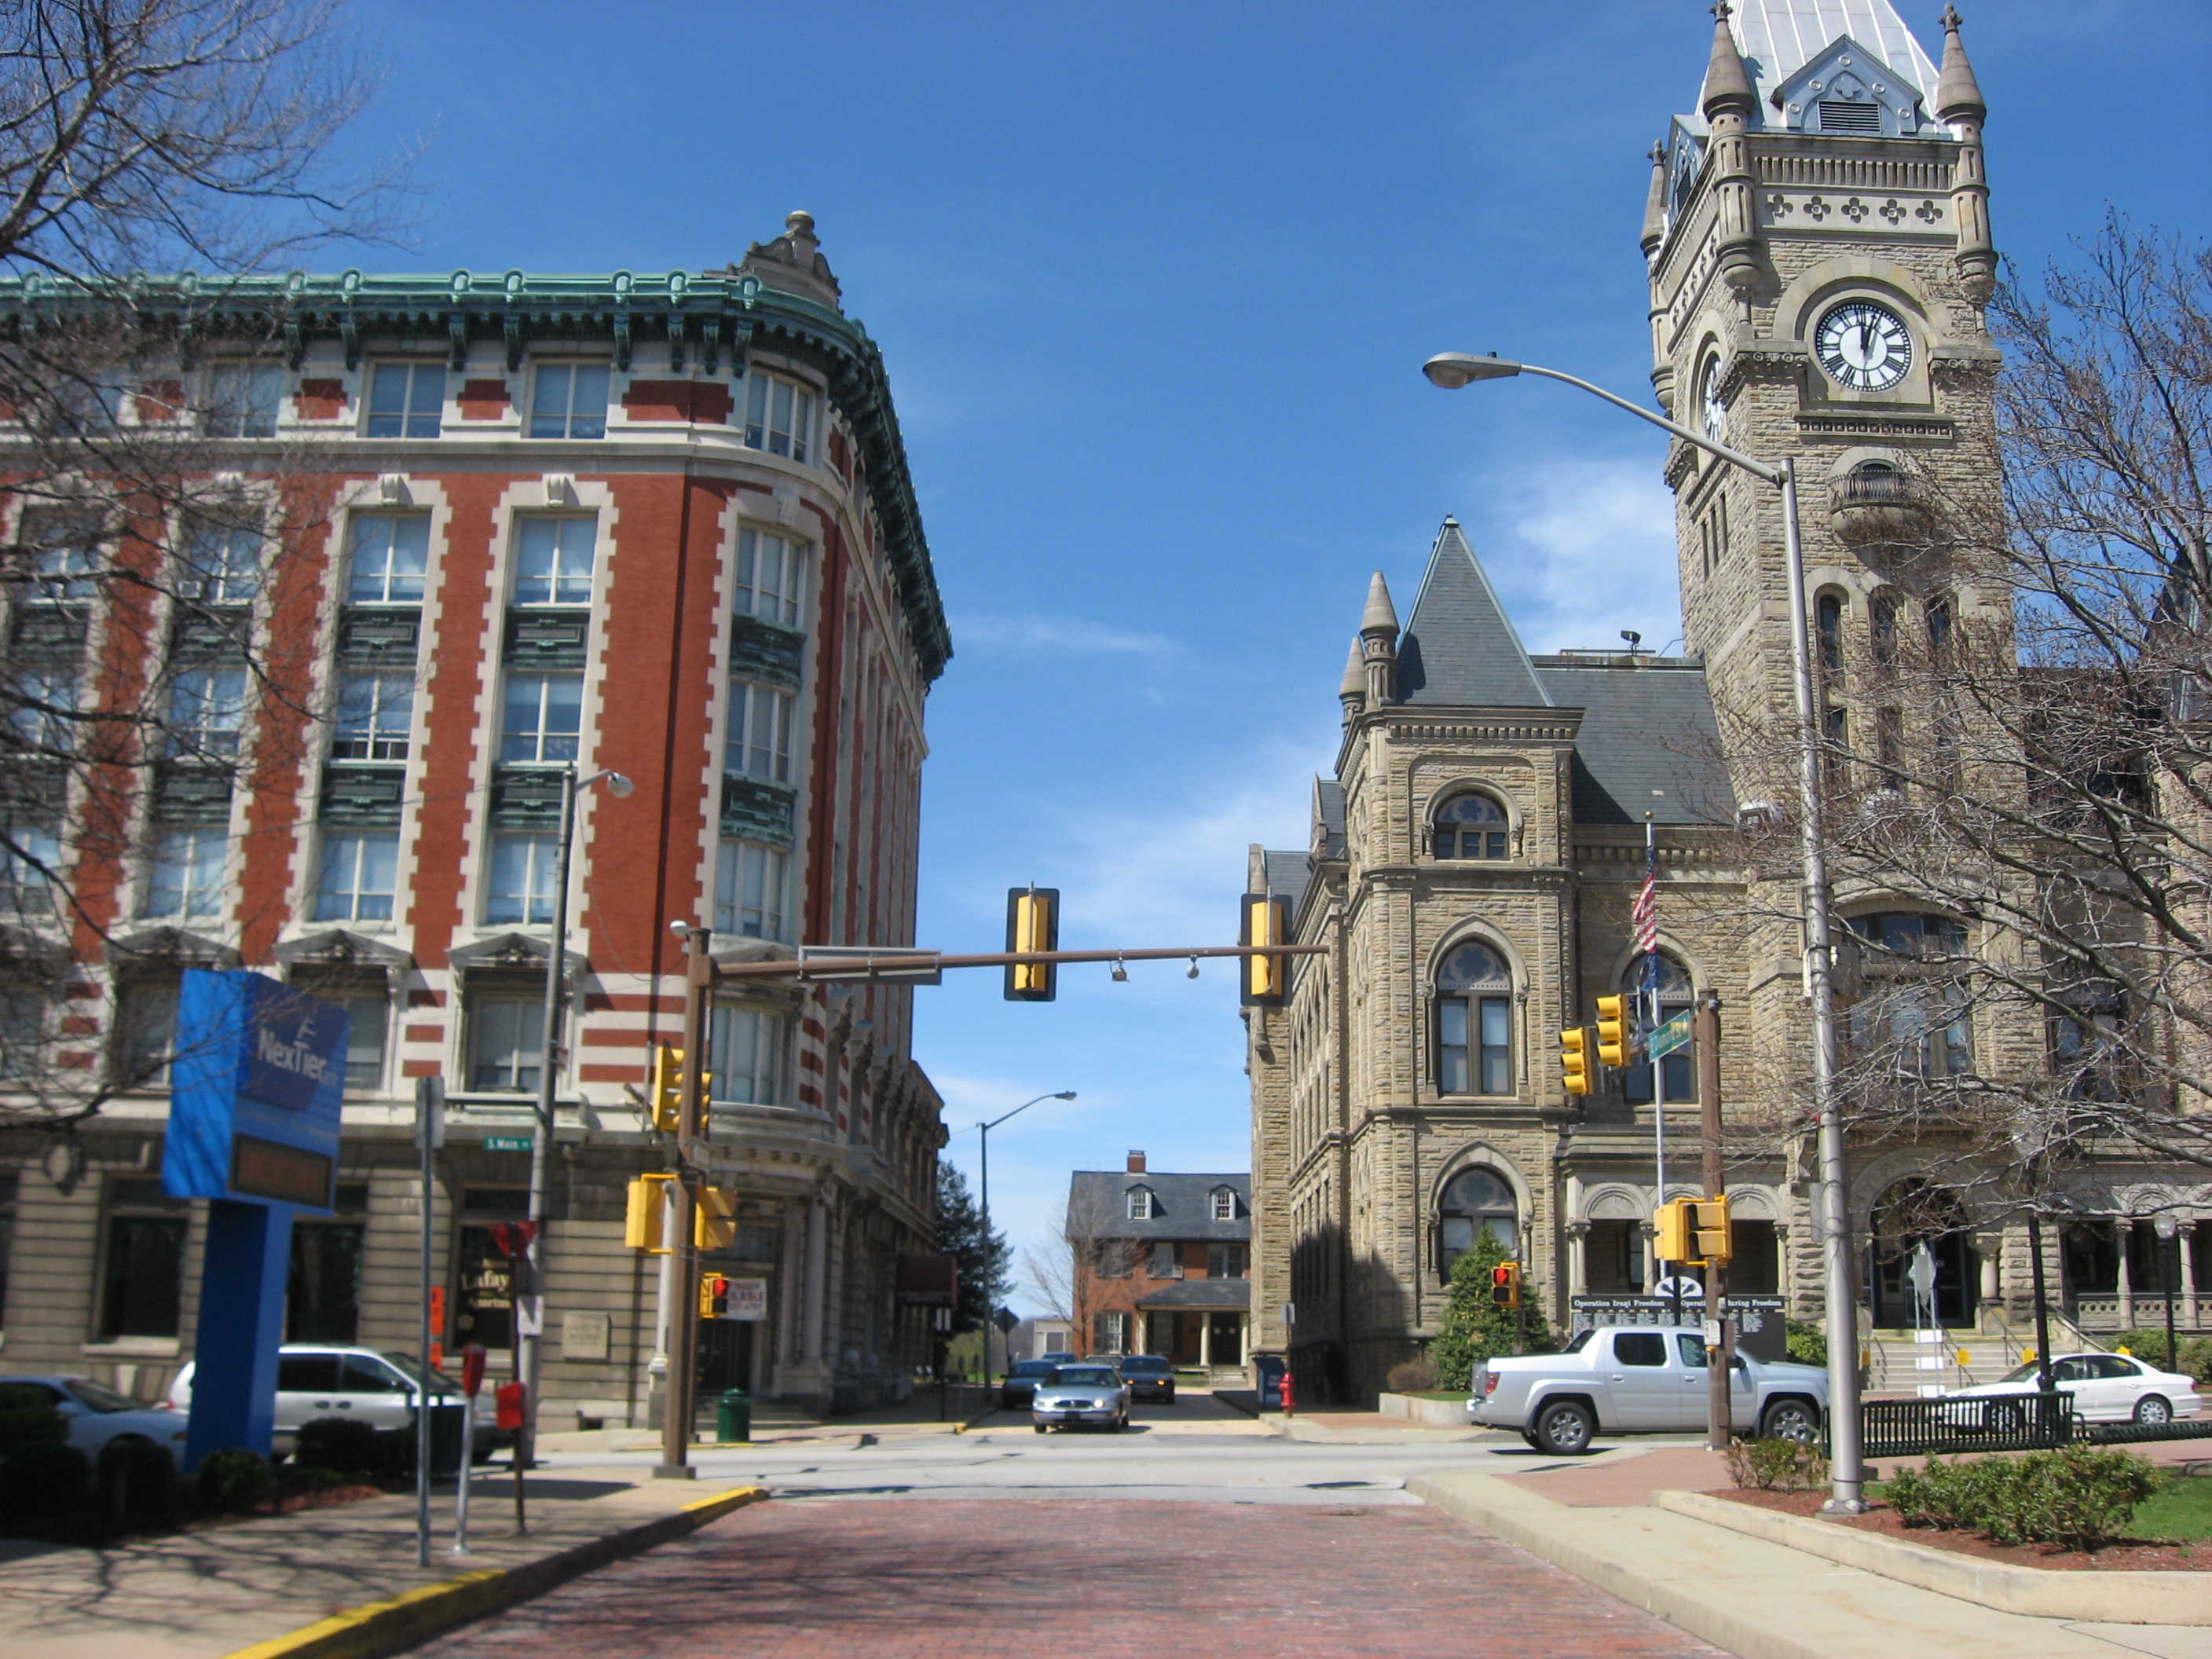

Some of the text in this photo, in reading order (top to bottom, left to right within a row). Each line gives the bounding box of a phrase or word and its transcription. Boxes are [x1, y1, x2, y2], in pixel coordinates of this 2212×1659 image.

[258, 1027, 327, 1082] NexTier
[496, 1138, 518, 1149] Main
[460, 1269, 510, 1292] Lafay
[1573, 1299, 1610, 1309] Operation
[1612, 1299, 1632, 1309] Iraqi
[1680, 1300, 1706, 1309] Operati
